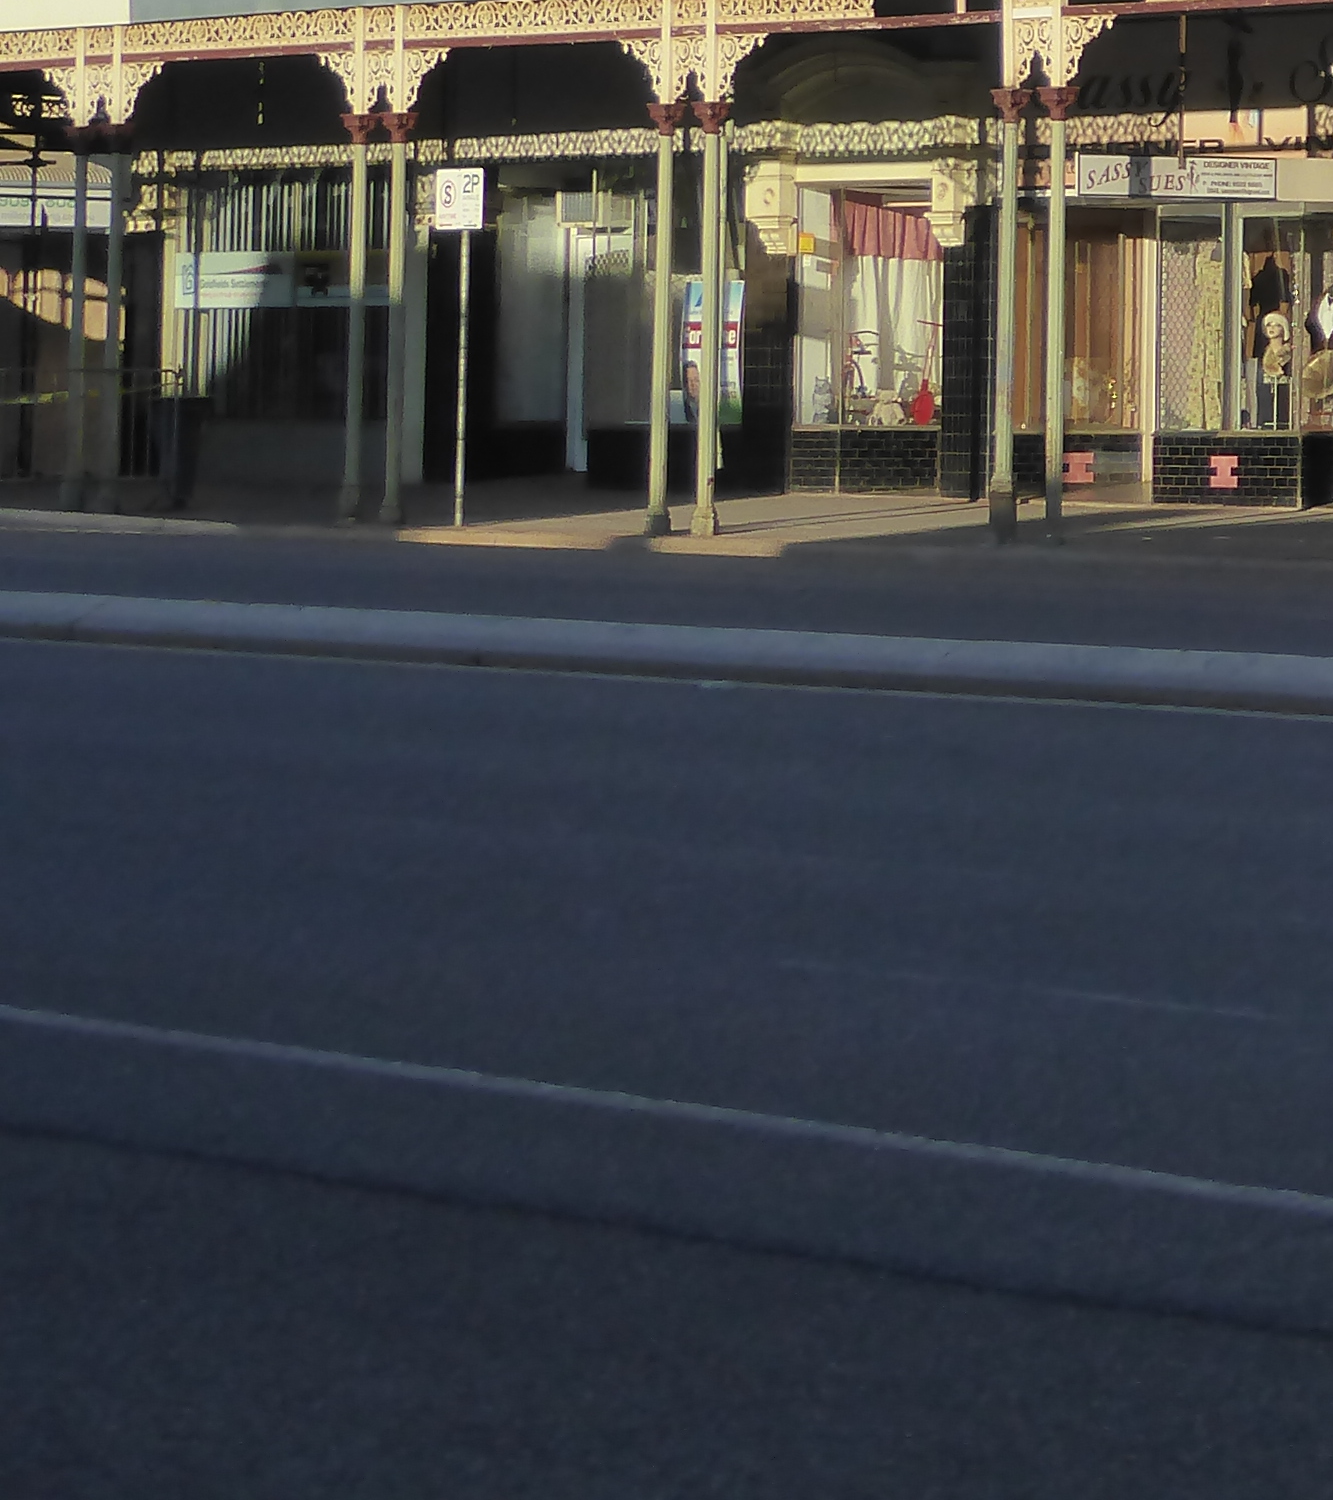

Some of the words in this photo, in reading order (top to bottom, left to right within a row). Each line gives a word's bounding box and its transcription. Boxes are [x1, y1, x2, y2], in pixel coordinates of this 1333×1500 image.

[1076, 65, 1192, 128] assy
[462, 173, 480, 194] 2P
[1086, 158, 1149, 191] SASSY
[1138, 173, 1186, 195] SUES
